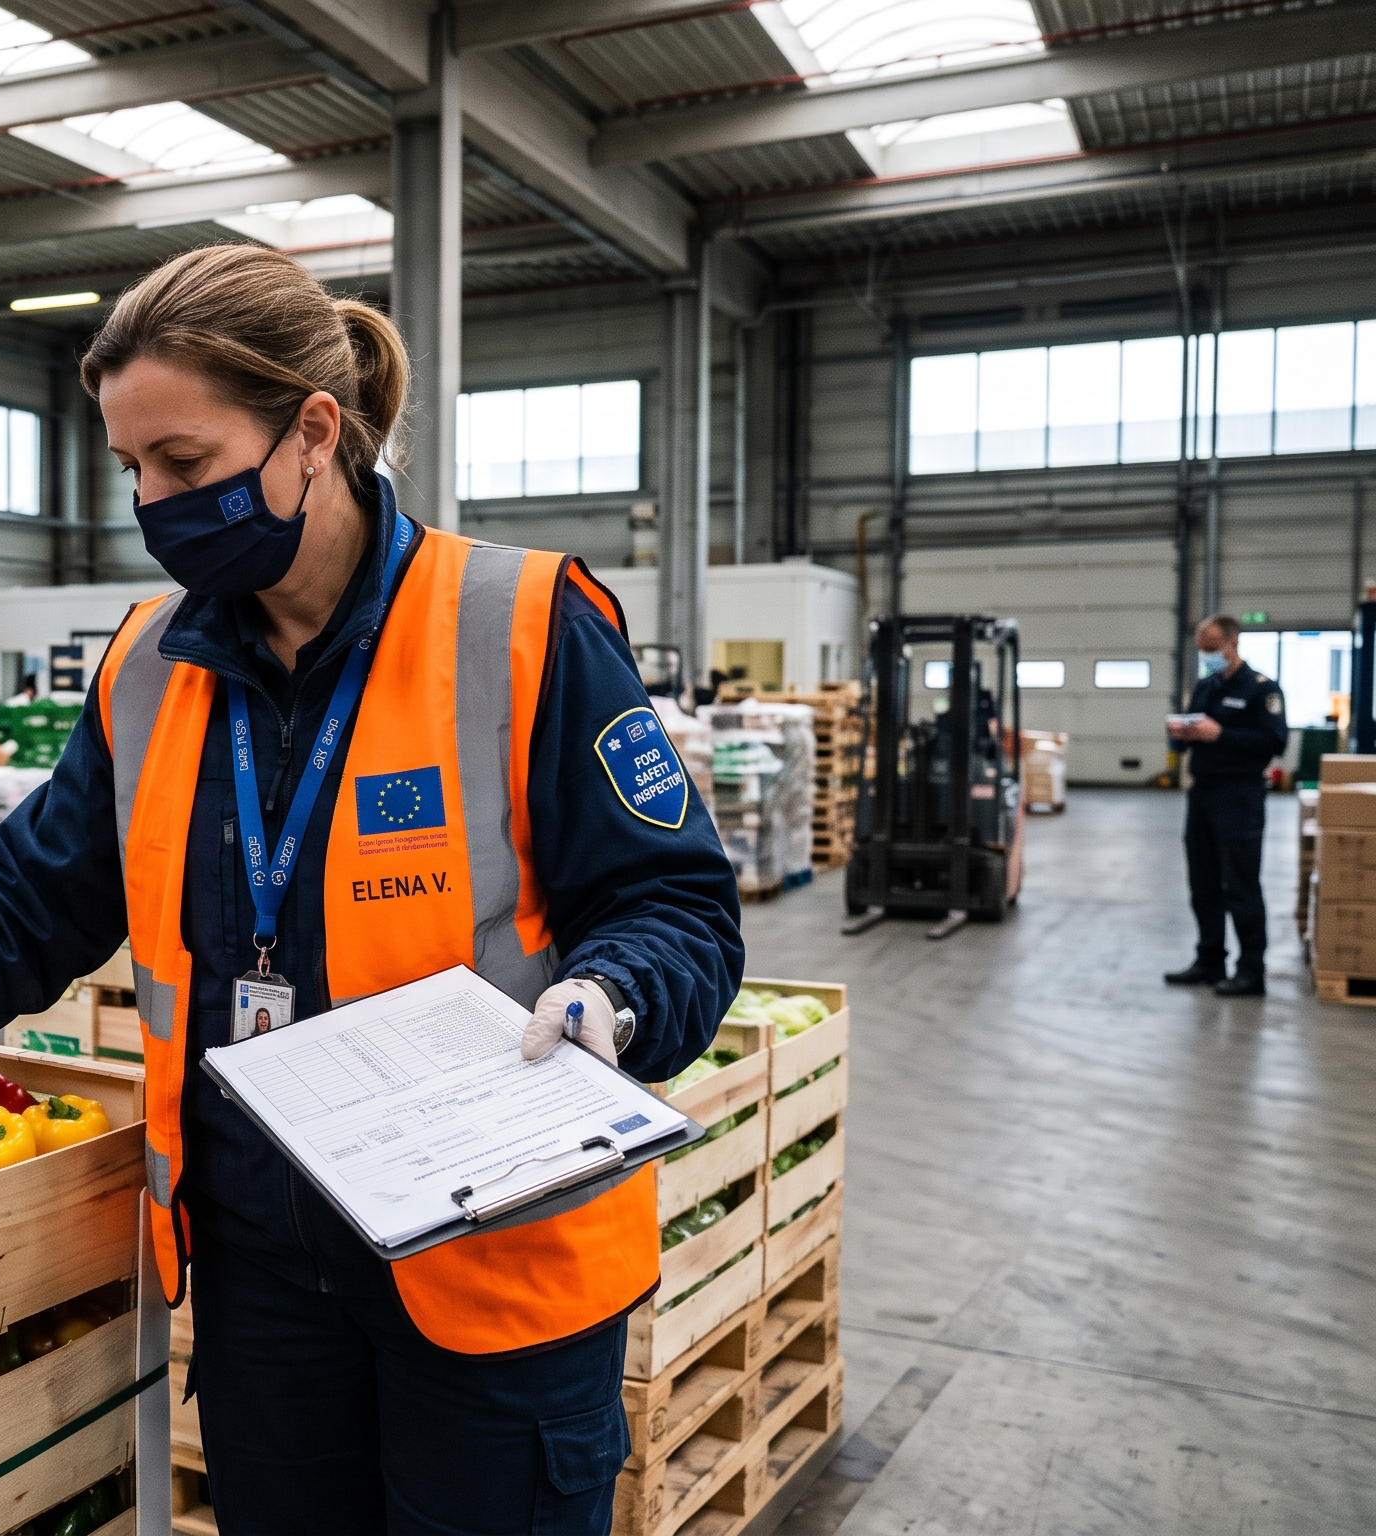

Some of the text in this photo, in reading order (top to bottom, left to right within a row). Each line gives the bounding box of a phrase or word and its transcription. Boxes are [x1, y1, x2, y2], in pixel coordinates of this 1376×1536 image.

[635, 761, 671, 787] SAFETY
[352, 871, 452, 902] ELENA V.
